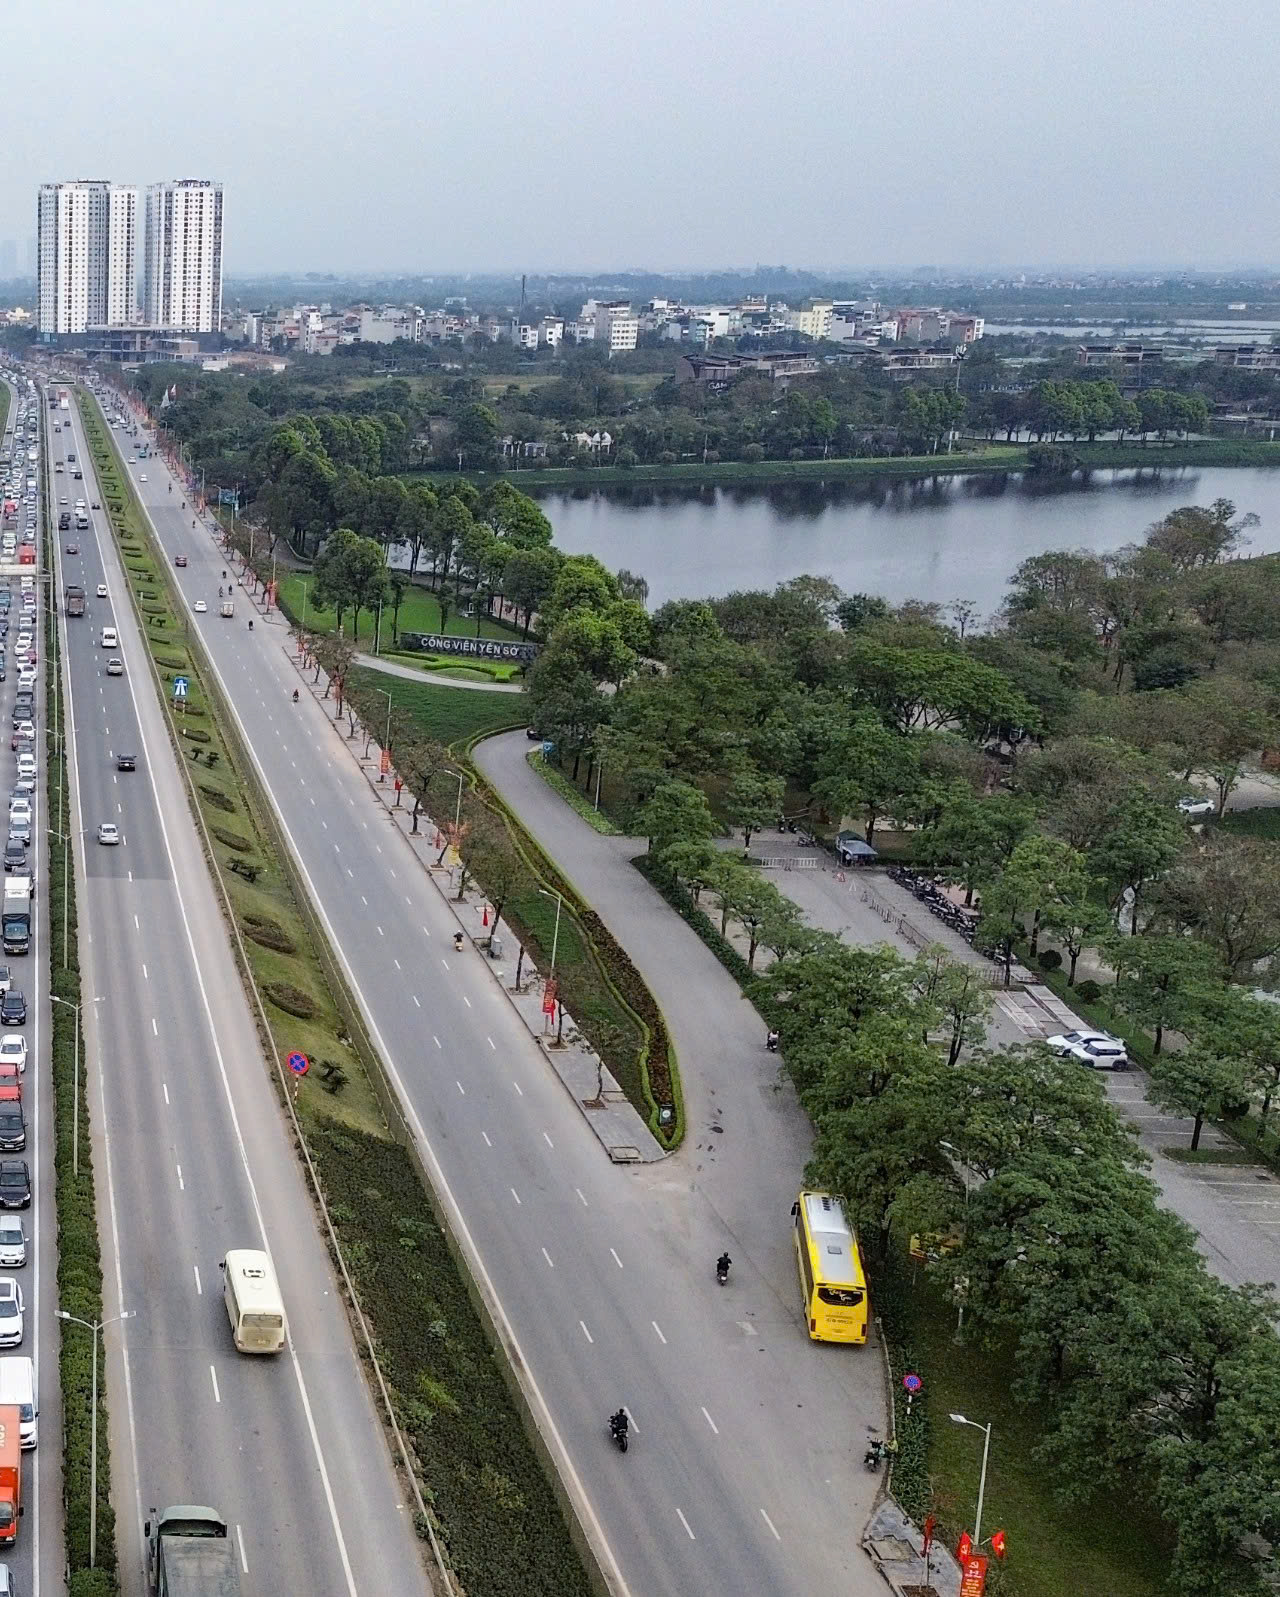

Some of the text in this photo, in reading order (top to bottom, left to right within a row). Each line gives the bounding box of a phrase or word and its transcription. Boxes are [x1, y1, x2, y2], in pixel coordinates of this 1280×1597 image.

[421, 637, 451, 649] CÔNG
[453, 640, 477, 652] VIÊN
[479, 643, 501, 654] YÊN
